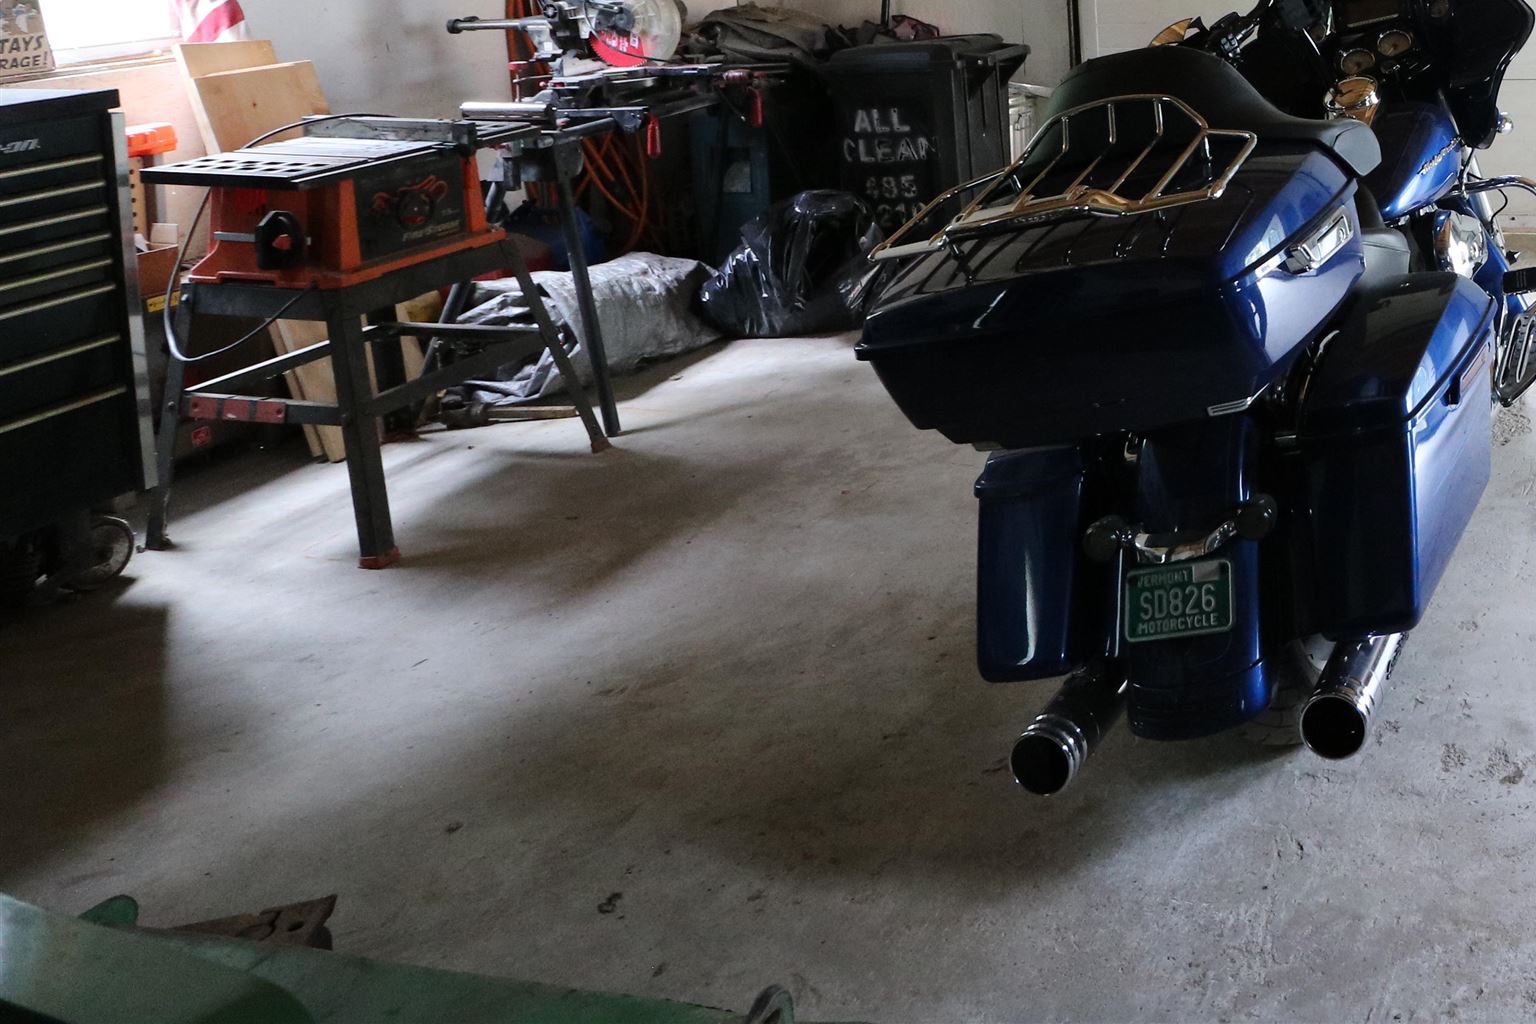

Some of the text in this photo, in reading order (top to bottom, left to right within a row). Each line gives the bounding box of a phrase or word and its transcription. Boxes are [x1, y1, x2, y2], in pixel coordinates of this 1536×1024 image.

[853, 108, 911, 133] ALL
[843, 137, 941, 163] CLEAN
[1137, 568, 1189, 589] VERMONT
[1140, 583, 1217, 621] SD826
[1137, 612, 1219, 635] MOTORCYCLE
